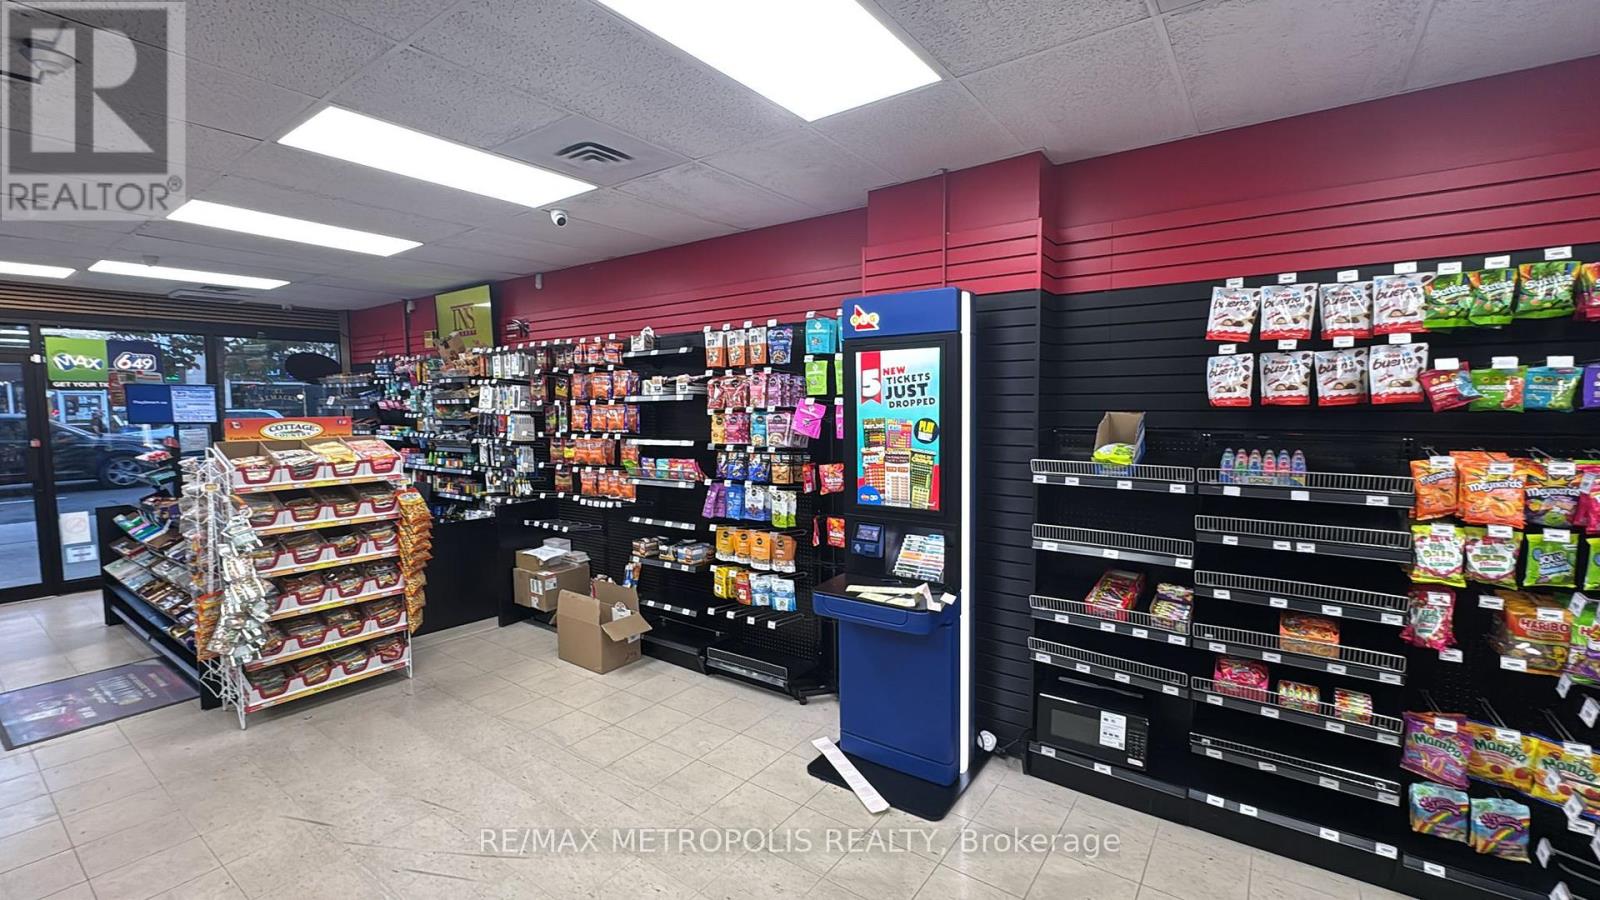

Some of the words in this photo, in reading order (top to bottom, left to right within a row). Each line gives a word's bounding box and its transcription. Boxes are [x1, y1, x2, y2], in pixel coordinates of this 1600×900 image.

[1375, 286, 1418, 302] bueno
[117, 354, 152, 369] 649
[1372, 357, 1412, 371] bueno
[883, 366, 906, 376] NEW
[886, 372, 931, 385] TICKETS
[862, 368, 882, 398] 5
[885, 383, 928, 399] JUST
[889, 397, 936, 409] DROPPED
[269, 423, 315, 432] COTTAGE
[1519, 619, 1569, 633] HARIBO
[1413, 733, 1462, 758] Mamba
[1474, 738, 1527, 763] Mamba
[1541, 757, 1596, 782] Mamba
